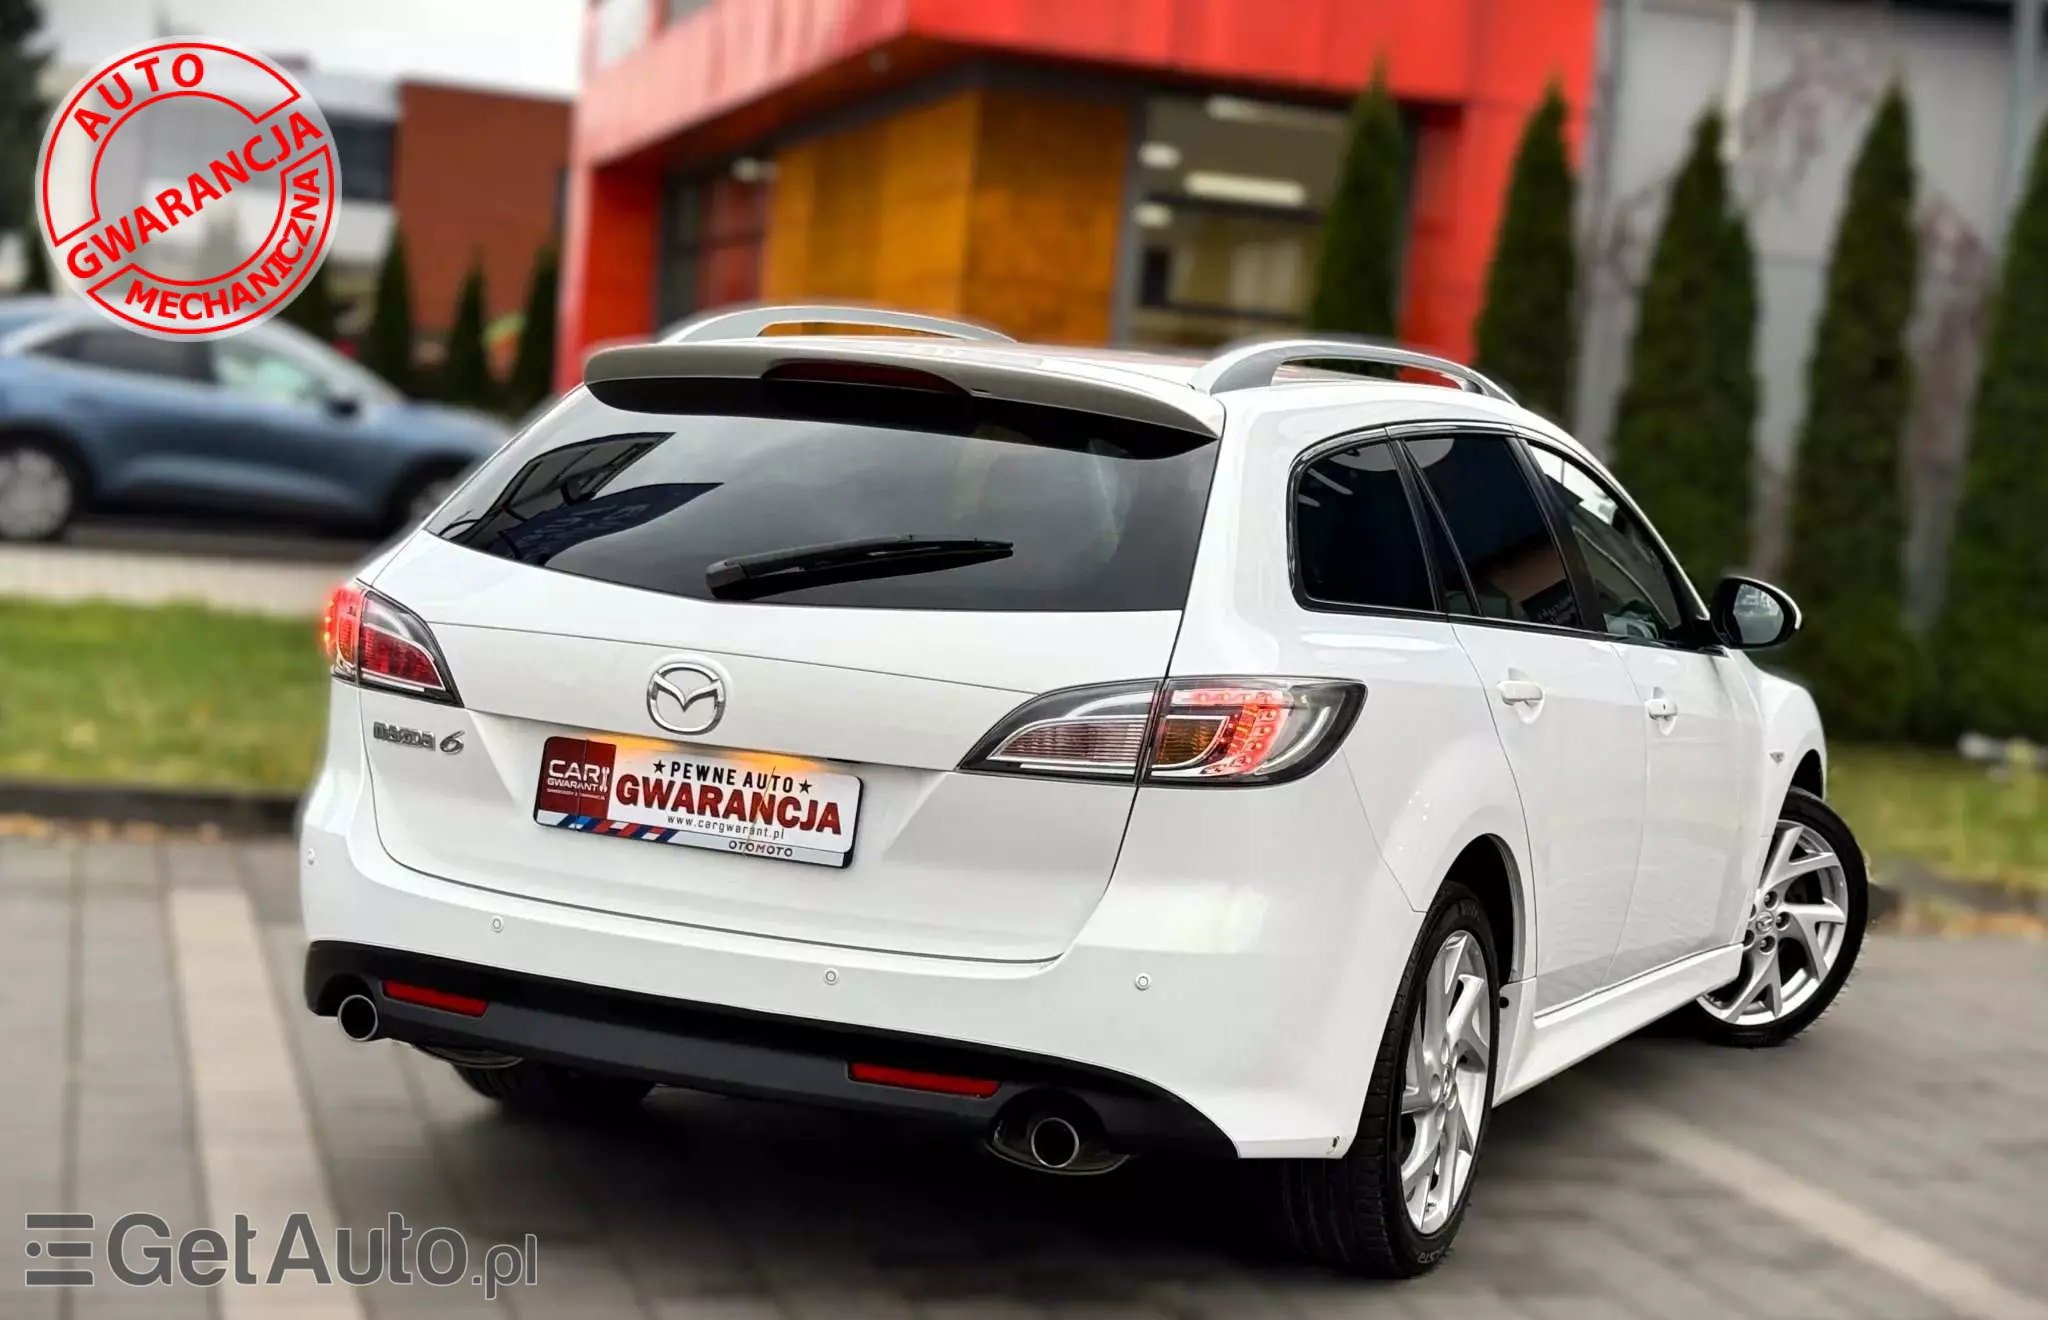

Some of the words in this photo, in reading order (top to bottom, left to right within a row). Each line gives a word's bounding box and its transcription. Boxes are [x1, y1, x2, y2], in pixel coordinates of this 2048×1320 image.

[439, 729, 466, 755] 6
[549, 759, 601, 783] CAR
[670, 761, 737, 785] PEWNE
[742, 770, 794, 794] AUTO
[547, 777, 599, 792] GWARANT
[615, 773, 842, 835] GWARANCJA
[666, 814, 785, 840] www.cargwarant.pl
[728, 840, 793, 858] OTOMOTO
